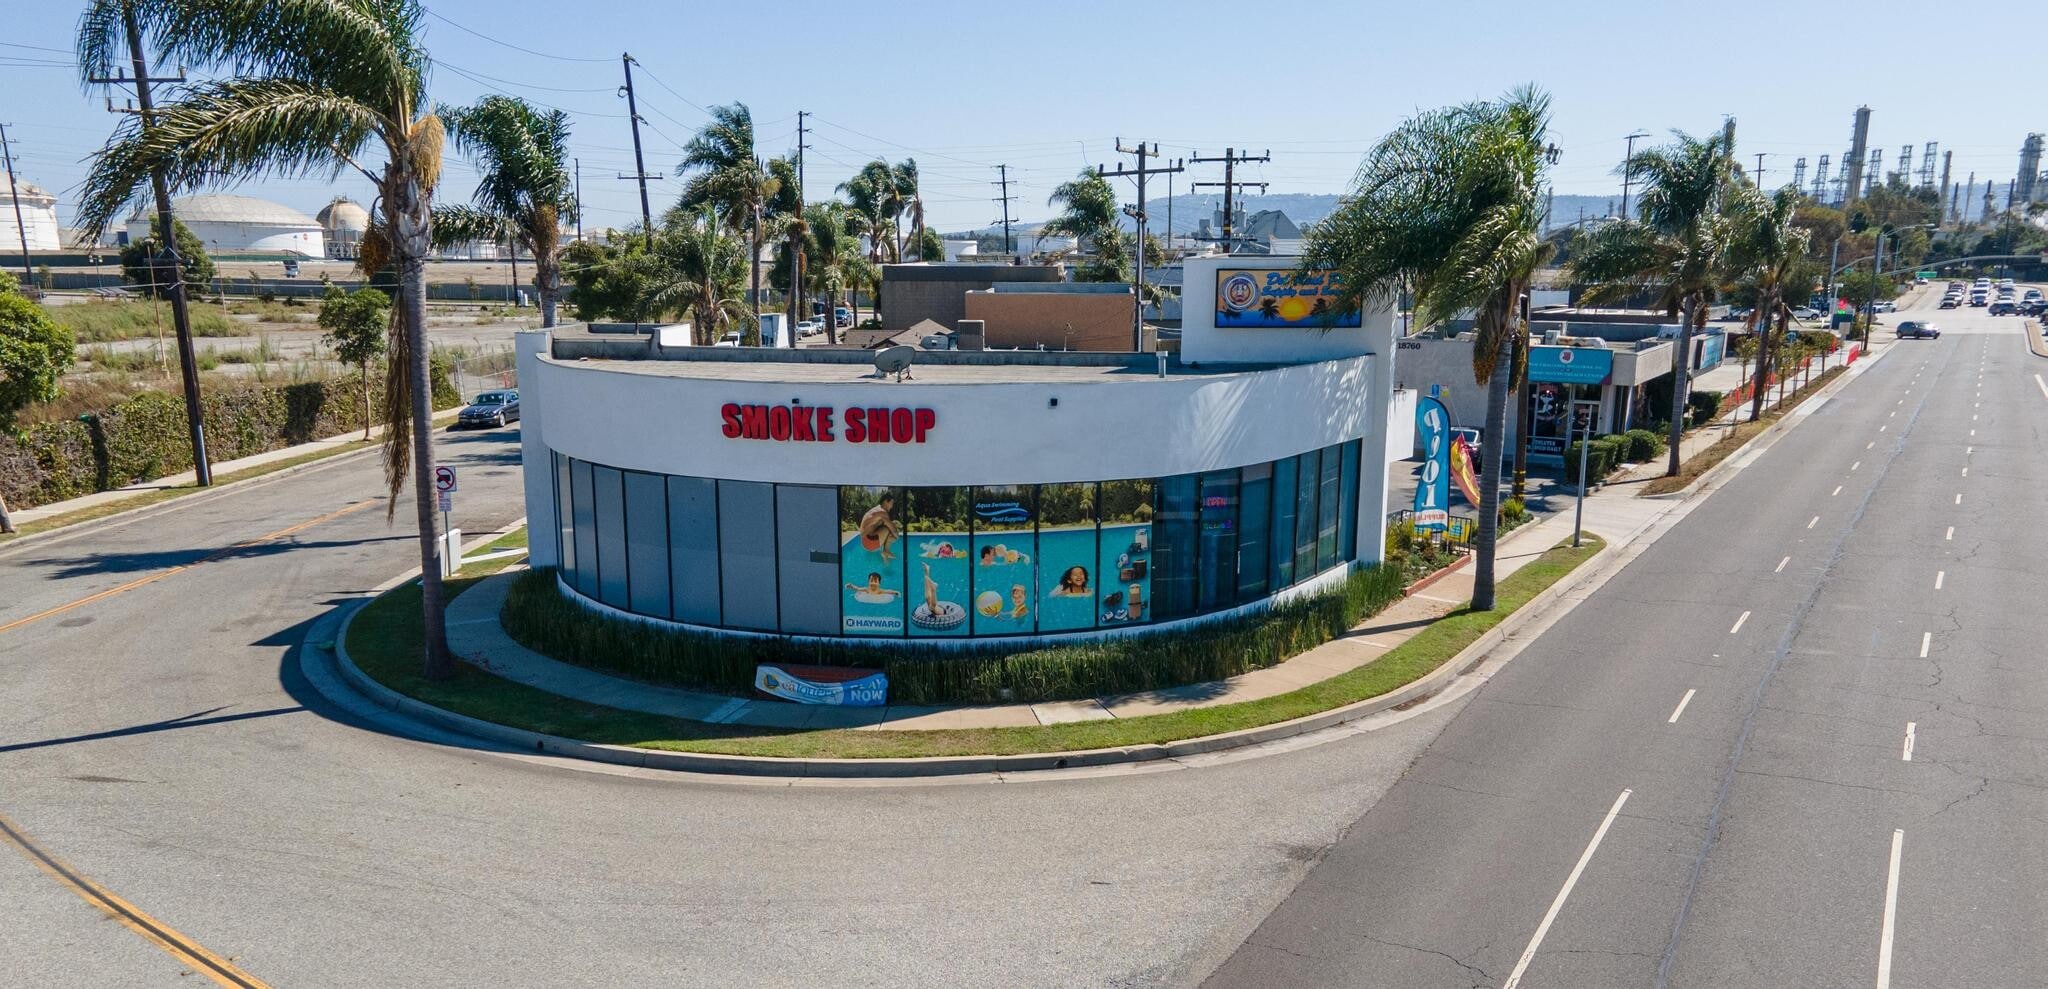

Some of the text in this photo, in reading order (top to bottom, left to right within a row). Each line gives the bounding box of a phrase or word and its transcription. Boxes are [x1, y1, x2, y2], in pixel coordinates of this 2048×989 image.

[721, 403, 936, 443] SMOKE SHOP
[1206, 496, 1226, 507] OPEN
[856, 619, 901, 629] HAYWARD
[851, 690, 883, 701] NOW
